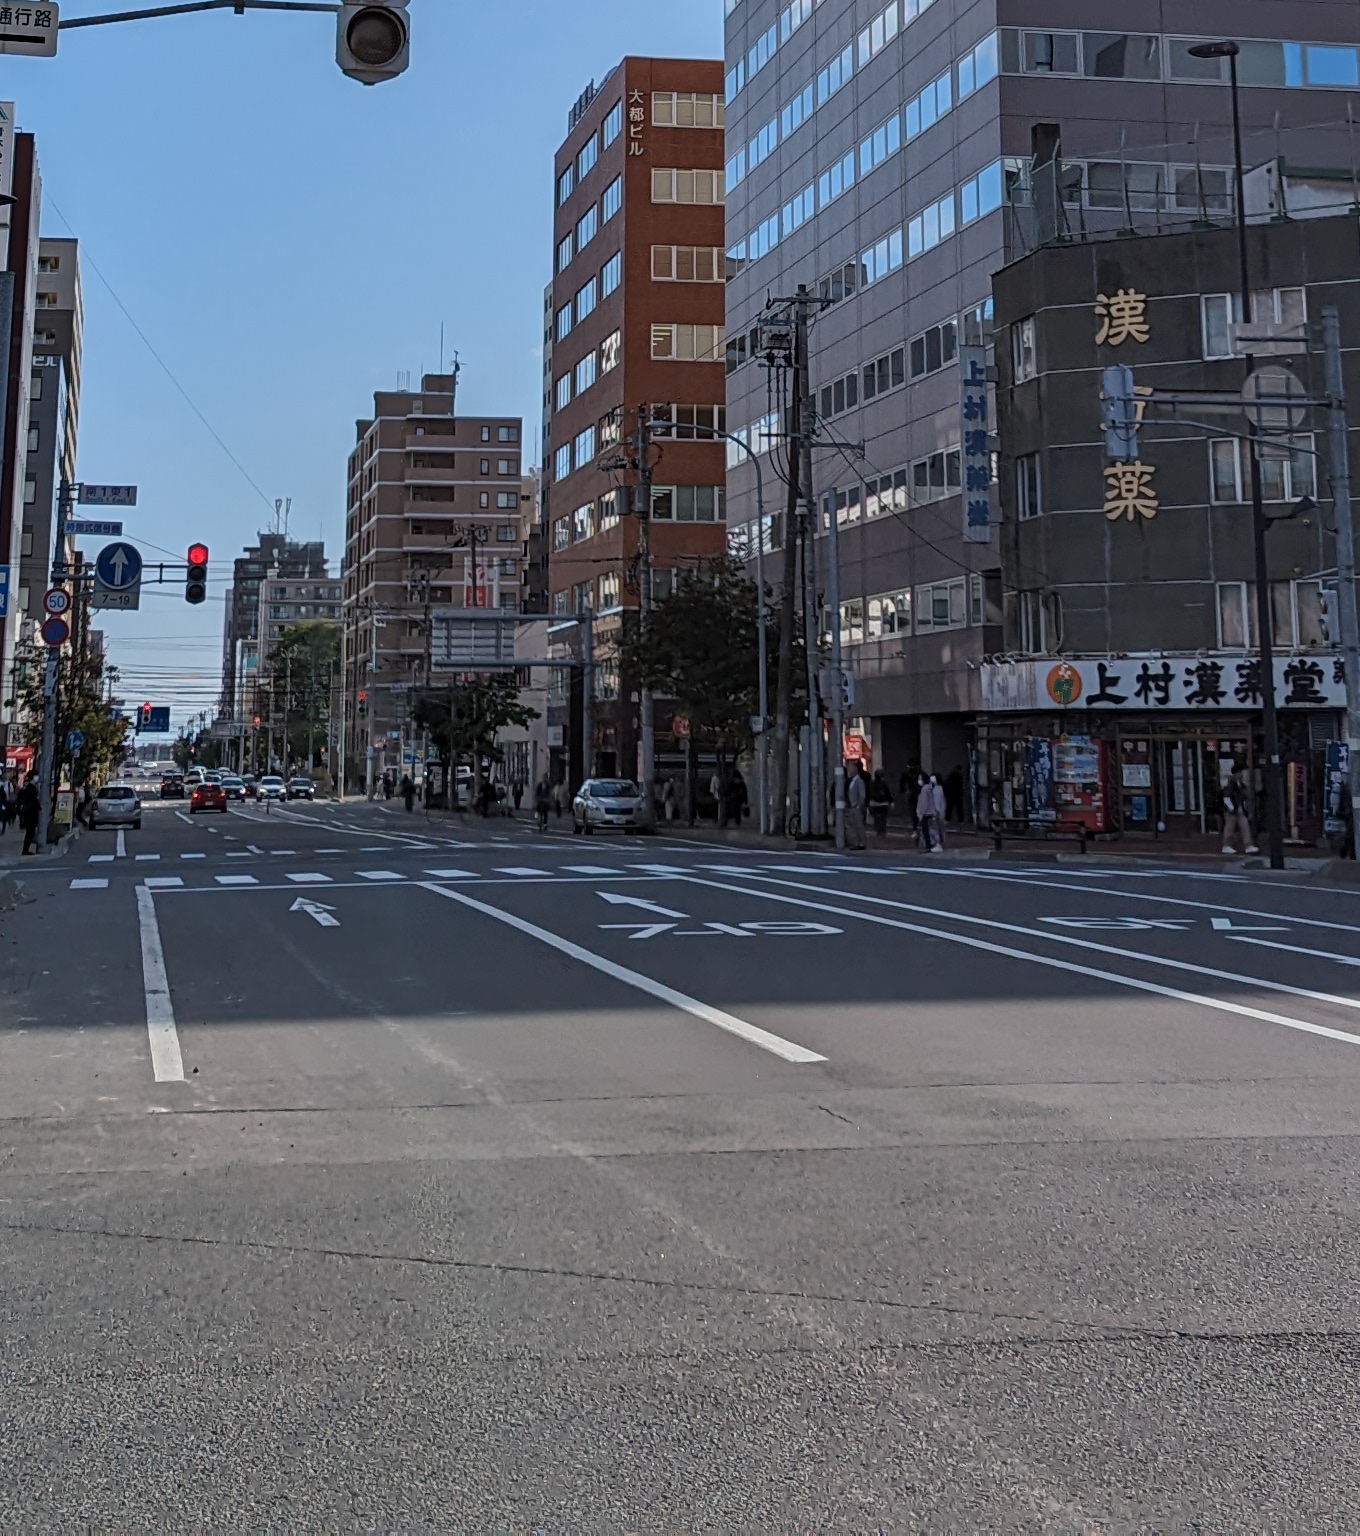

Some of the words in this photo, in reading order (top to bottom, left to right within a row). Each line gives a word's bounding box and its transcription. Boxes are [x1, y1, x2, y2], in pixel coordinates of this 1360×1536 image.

[628, 88, 645, 156] 大都ビル
[49, 595, 65, 608] 50
